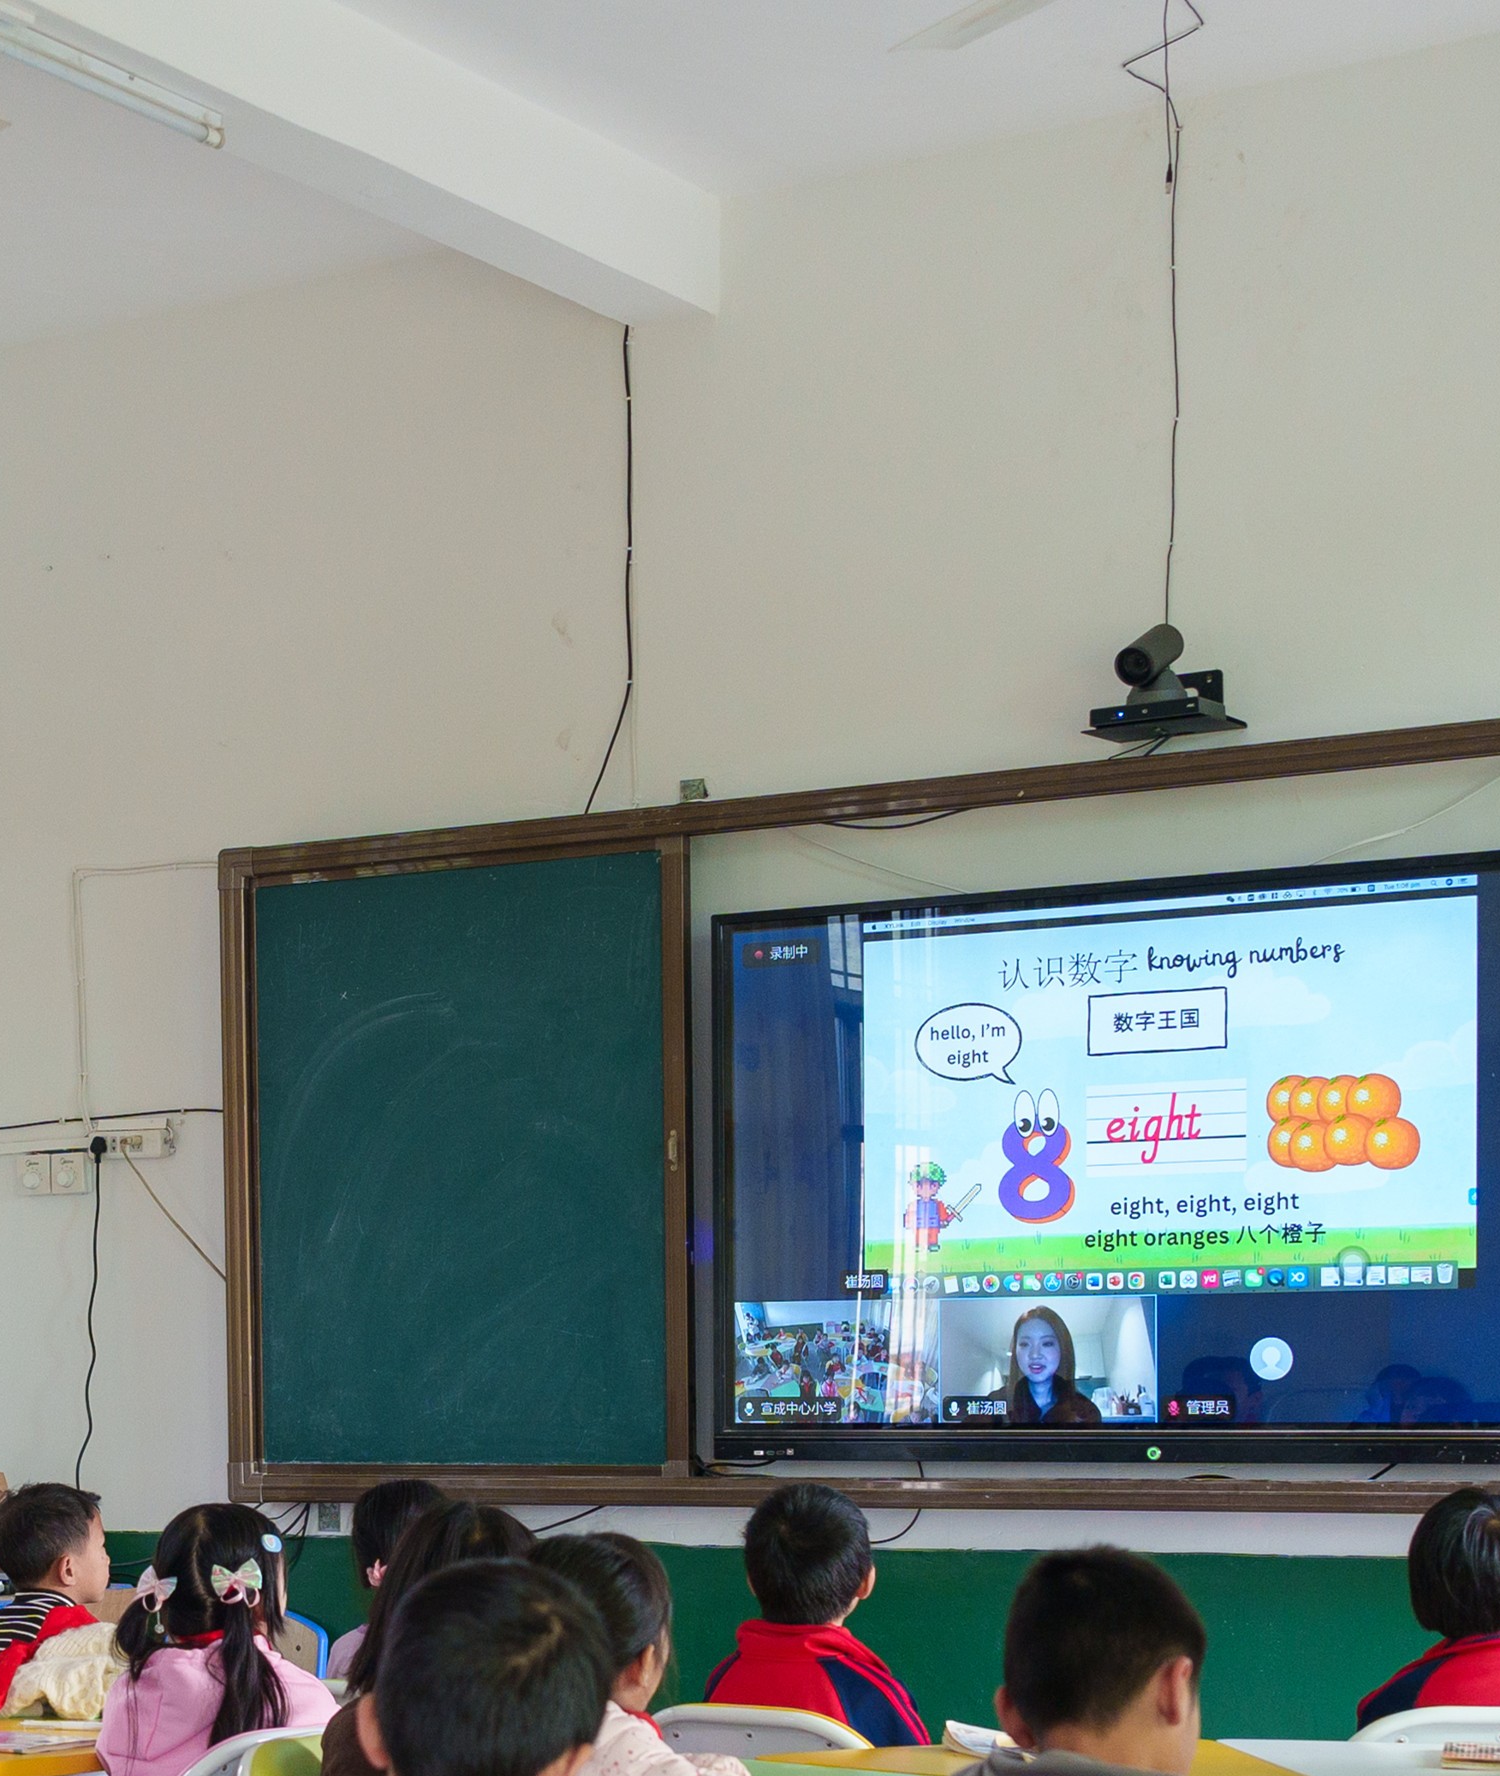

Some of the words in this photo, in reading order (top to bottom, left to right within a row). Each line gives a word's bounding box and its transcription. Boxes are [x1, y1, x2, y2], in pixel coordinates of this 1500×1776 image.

[769, 944, 808, 960] 录制中
[1147, 946, 1242, 978] knowing
[1249, 937, 1345, 964] numbers
[997, 949, 1138, 991] 认识数字
[1113, 1008, 1200, 1033] 数字王国
[930, 1024, 976, 1042] hello,
[947, 1049, 989, 1069] eight
[1106, 1092, 1202, 1164] eight
[1110, 1197, 1169, 1220] eight,
[1176, 1194, 1237, 1217] eight,
[1243, 1192, 1300, 1215] eight
[1084, 1229, 1137, 1252] eight
[1143, 1230, 1229, 1249] oranges
[1236, 1221, 1326, 1245] 八个橙子
[760, 1401, 837, 1416] 宣成中心小学
[967, 1400, 1007, 1416] 崔汤圆
[1186, 1400, 1230, 1415] 管理员
